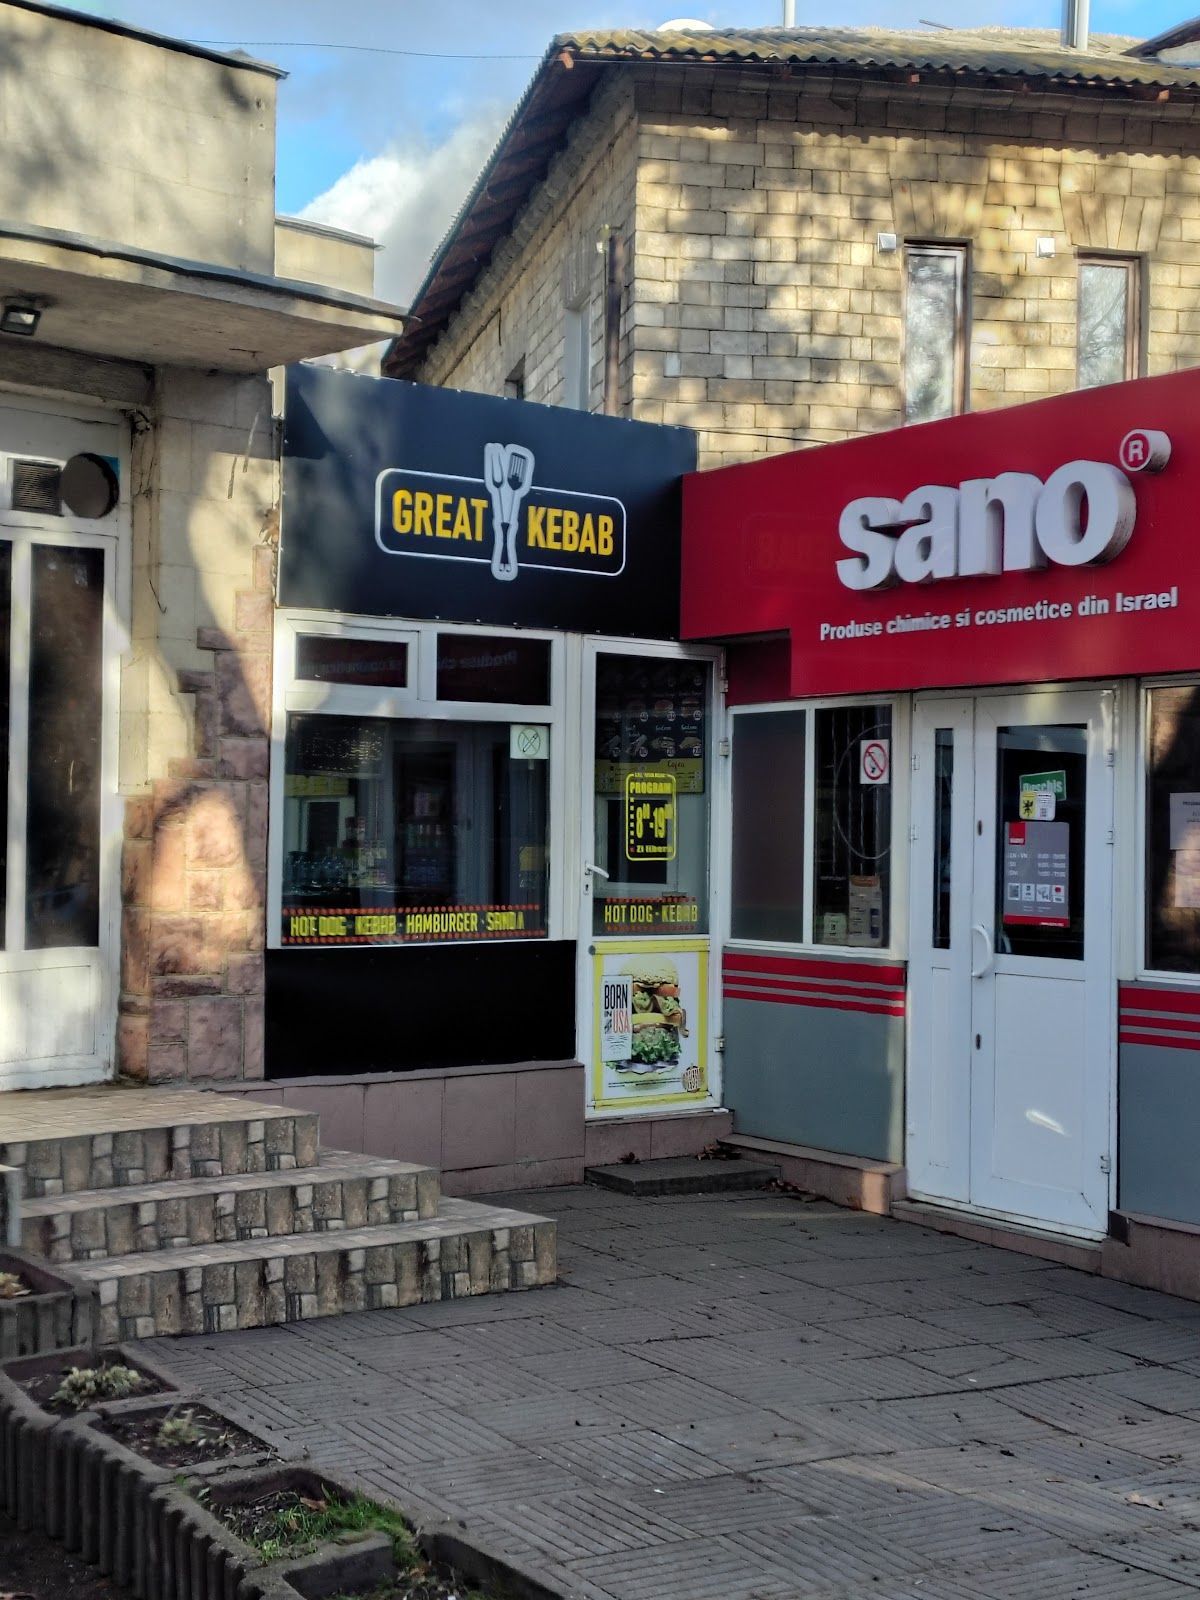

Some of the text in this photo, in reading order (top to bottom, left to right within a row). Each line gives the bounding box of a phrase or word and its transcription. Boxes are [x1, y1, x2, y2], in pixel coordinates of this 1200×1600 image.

[392, 489, 614, 556] GREAT KEBAB
[835, 459, 1136, 591] sano
[820, 620, 883, 641] Produse
[886, 612, 951, 634] chimice
[975, 600, 1072, 626] cosmetice
[1078, 595, 1109, 616] din
[1116, 586, 1178, 613] Israel
[630, 782, 672, 794] PROGRAM
[290, 916, 317, 937] HOT
[319, 916, 347, 936] DOG
[355, 915, 396, 936] KEBAB
[406, 913, 478, 934] HAMBURGER
[605, 905, 698, 923] HOT DOG KEBAB
[604, 984, 628, 1009] BORN
[613, 1009, 631, 1034] USA
